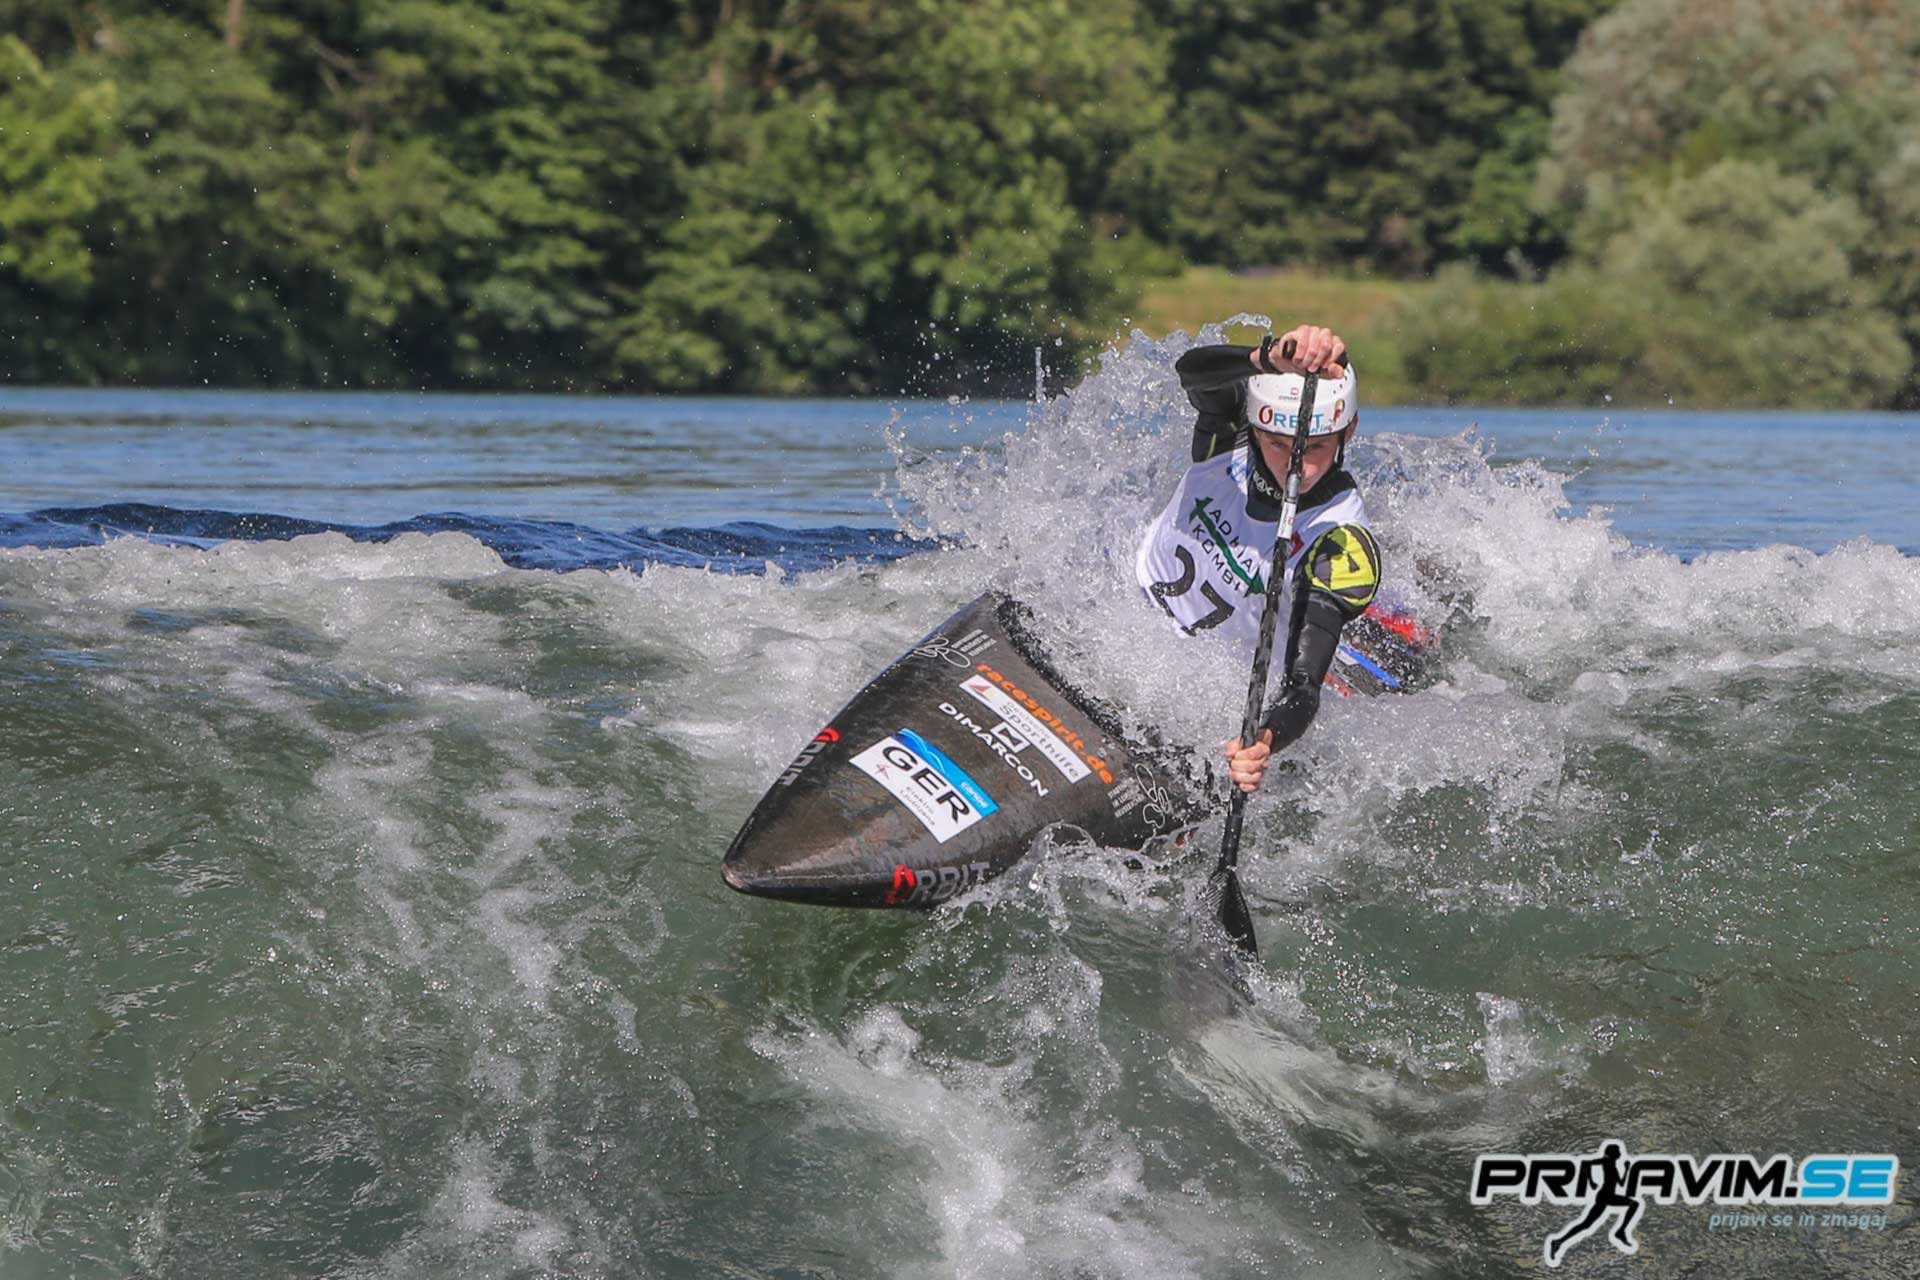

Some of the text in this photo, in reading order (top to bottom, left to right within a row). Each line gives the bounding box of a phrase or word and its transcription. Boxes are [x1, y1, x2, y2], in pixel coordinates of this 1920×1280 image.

[1259, 405, 1325, 429] ORBT
[1192, 524, 1241, 591] KOMBI
[938, 702, 1049, 797] DIMARCON
[1000, 705, 1079, 779] Sporthilfe
[882, 746, 970, 824] GER
